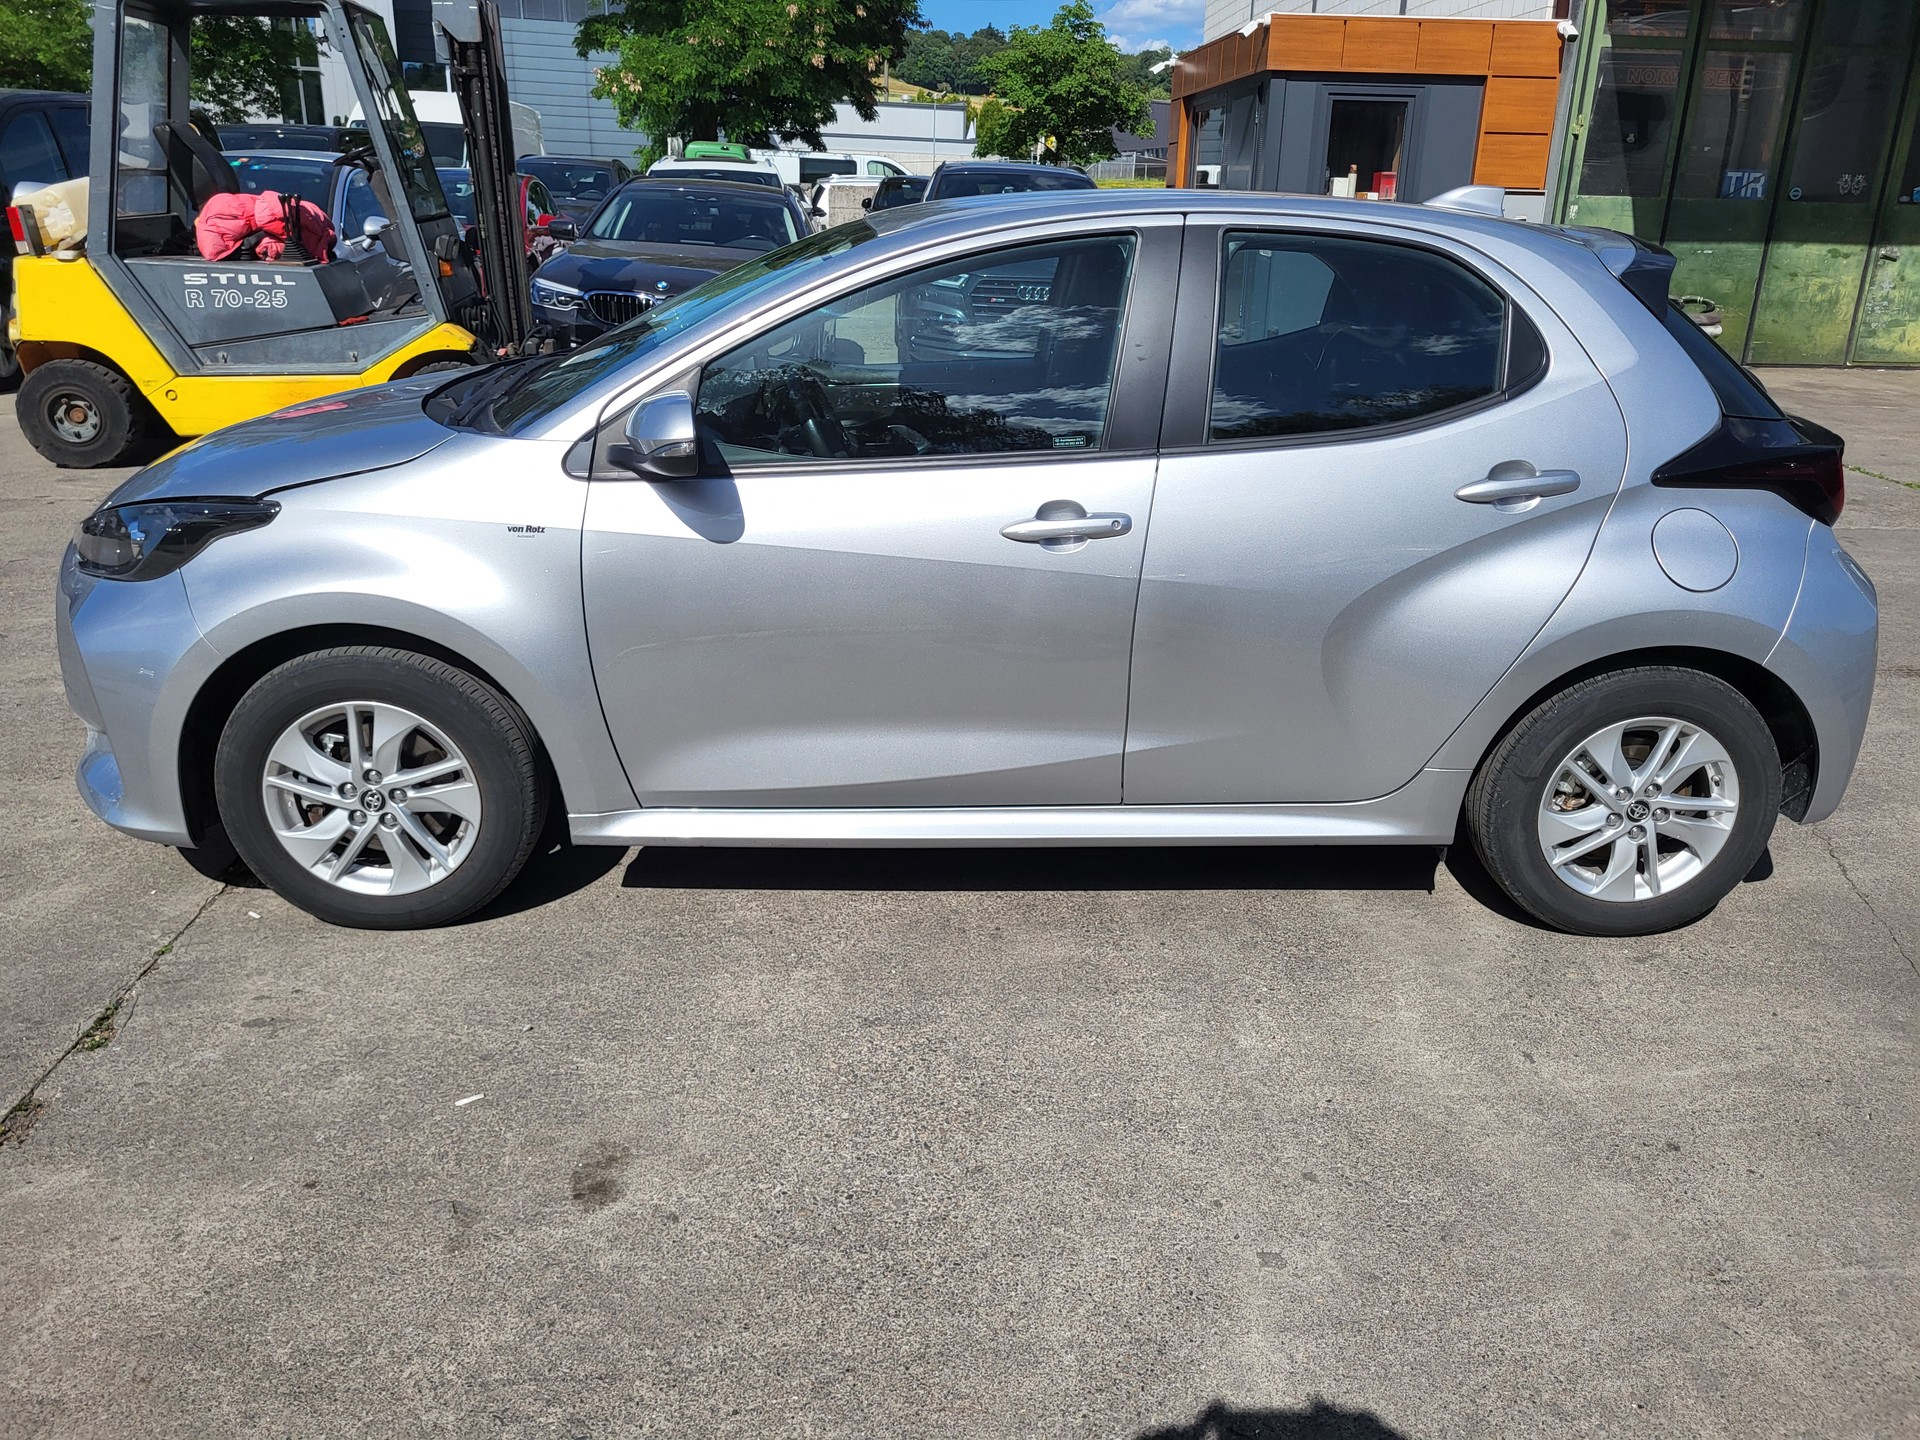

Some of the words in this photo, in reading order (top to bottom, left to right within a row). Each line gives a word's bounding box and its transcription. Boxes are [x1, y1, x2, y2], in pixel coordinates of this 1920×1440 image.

[1627, 68, 1742, 87] NORGEN
[1727, 172, 1766, 198] TIR
[183, 273, 296, 286] STILL
[185, 289, 205, 308] R
[211, 289, 288, 308] 70-25
[525, 525, 546, 533] Rotz
